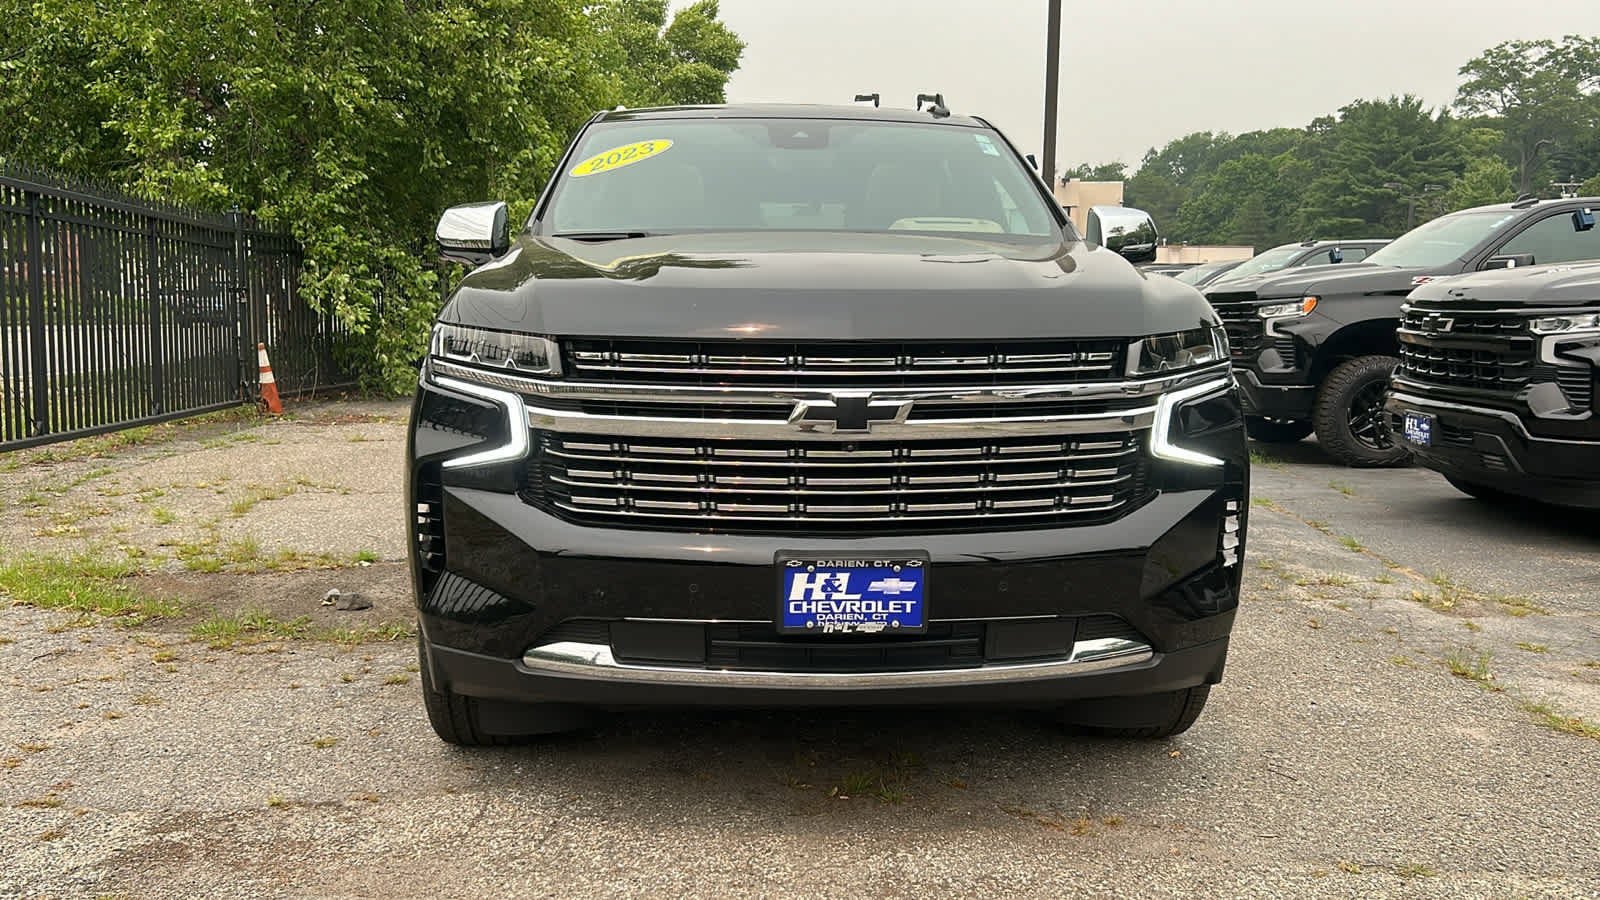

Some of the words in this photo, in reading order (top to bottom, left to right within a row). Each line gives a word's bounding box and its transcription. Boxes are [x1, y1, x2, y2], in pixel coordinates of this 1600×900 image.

[590, 143, 655, 172] 2023
[816, 560, 868, 568] DARIEN,
[789, 572, 862, 600] H&L
[789, 601, 916, 613] CHEVROLET
[816, 613, 867, 621] DARIEN,
